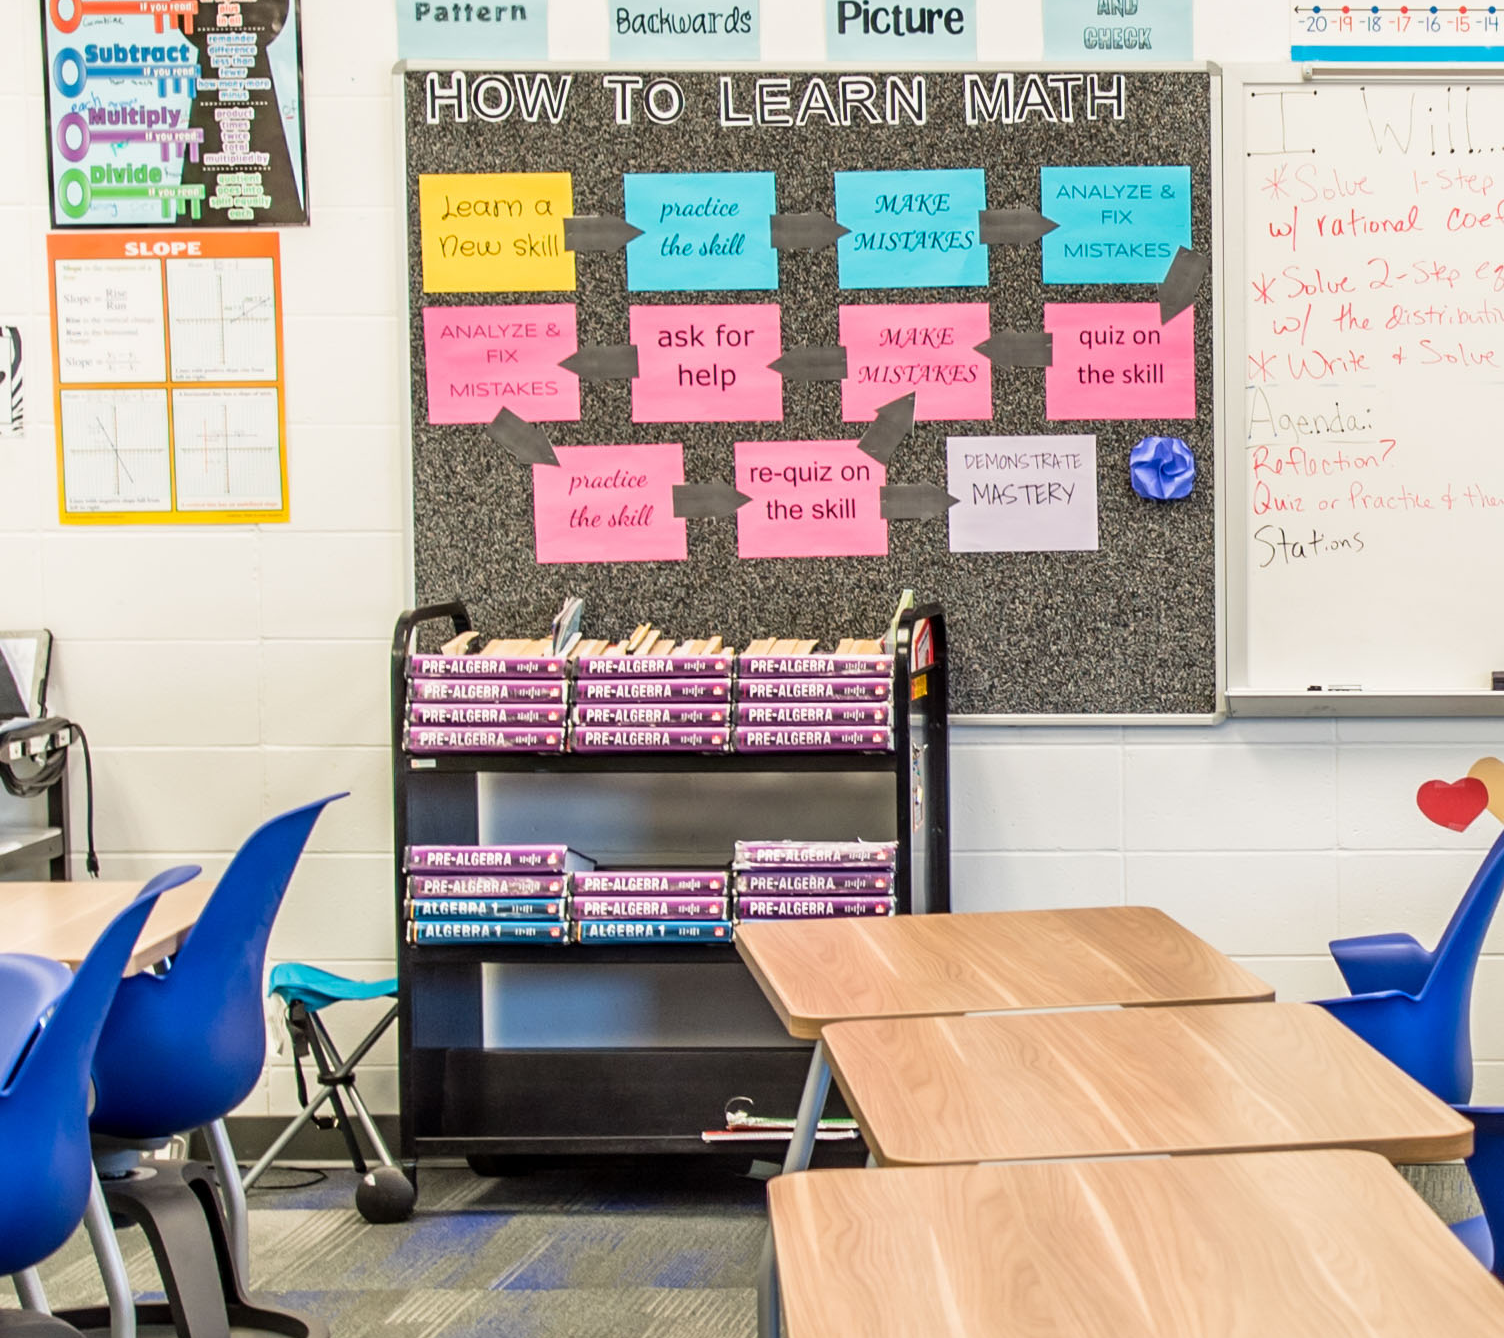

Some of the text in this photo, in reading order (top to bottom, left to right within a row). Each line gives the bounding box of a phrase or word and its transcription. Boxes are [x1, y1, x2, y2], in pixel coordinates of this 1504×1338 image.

[415, 2, 527, 22] Pattern
[616, 6, 752, 35] Backwards
[837, 0, 964, 36] Picture
[1299, 16, 1327, 32] -20
[1331, 16, 1352, 32] -19
[1389, 16, 1411, 32] -17
[1447, 16, 1470, 32] -15
[1083, 27, 1151, 51] CHECK
[85, 45, 190, 63] Subtract
[426, 73, 1126, 127] HOW TO LEARN MATH
[88, 107, 181, 127] Multiply
[91, 164, 162, 184] Divide
[1056, 185, 1175, 199] ANALYZE &
[441, 196, 552, 221] Learn a
[660, 197, 739, 224] practice
[874, 193, 950, 214] MAKE
[1101, 210, 1132, 224] FIX
[1318, 205, 1424, 237] rational
[124, 242, 202, 256] SLOPE
[513, 234, 559, 256] skill
[660, 233, 744, 256] the skill
[854, 231, 974, 251] MISTAKES
[1065, 243, 1171, 257] MISTAKES
[1284, 266, 1355, 298] Solve
[1333, 304, 1373, 331] the
[440, 322, 560, 339] ANALYZE &
[658, 324, 755, 347] ask for
[879, 327, 954, 347] MAKE
[1079, 326, 1160, 349] quiz on
[487, 349, 518, 363] FIX
[1420, 340, 1495, 368] Solve
[679, 365, 736, 390] help
[858, 365, 978, 385] MISTAKES
[1078, 363, 1164, 384] the skill
[450, 381, 558, 398] MISTAKES
[964, 453, 1082, 471] DEMONSTRATE
[568, 469, 648, 496] practice
[750, 462, 870, 488] re-quiz on
[972, 482, 1075, 507] MASTERY
[569, 505, 654, 529] the skill
[766, 498, 856, 521] the skill
[1254, 525, 1365, 568] Stations
[422, 659, 506, 674] PRE-ALGEBRA
[589, 659, 673, 674] PRE-ALGEBRA
[750, 659, 834, 673] PRE-ALGEBRA
[586, 708, 670, 723] PRE-ALGEBRA
[420, 731, 505, 746] PRE-ALGEBRA
[427, 852, 512, 867] PRE-ALGEBRA
[750, 901, 834, 916] PRE-ALGEBRA
[425, 924, 501, 938] ALGEBRA 1
